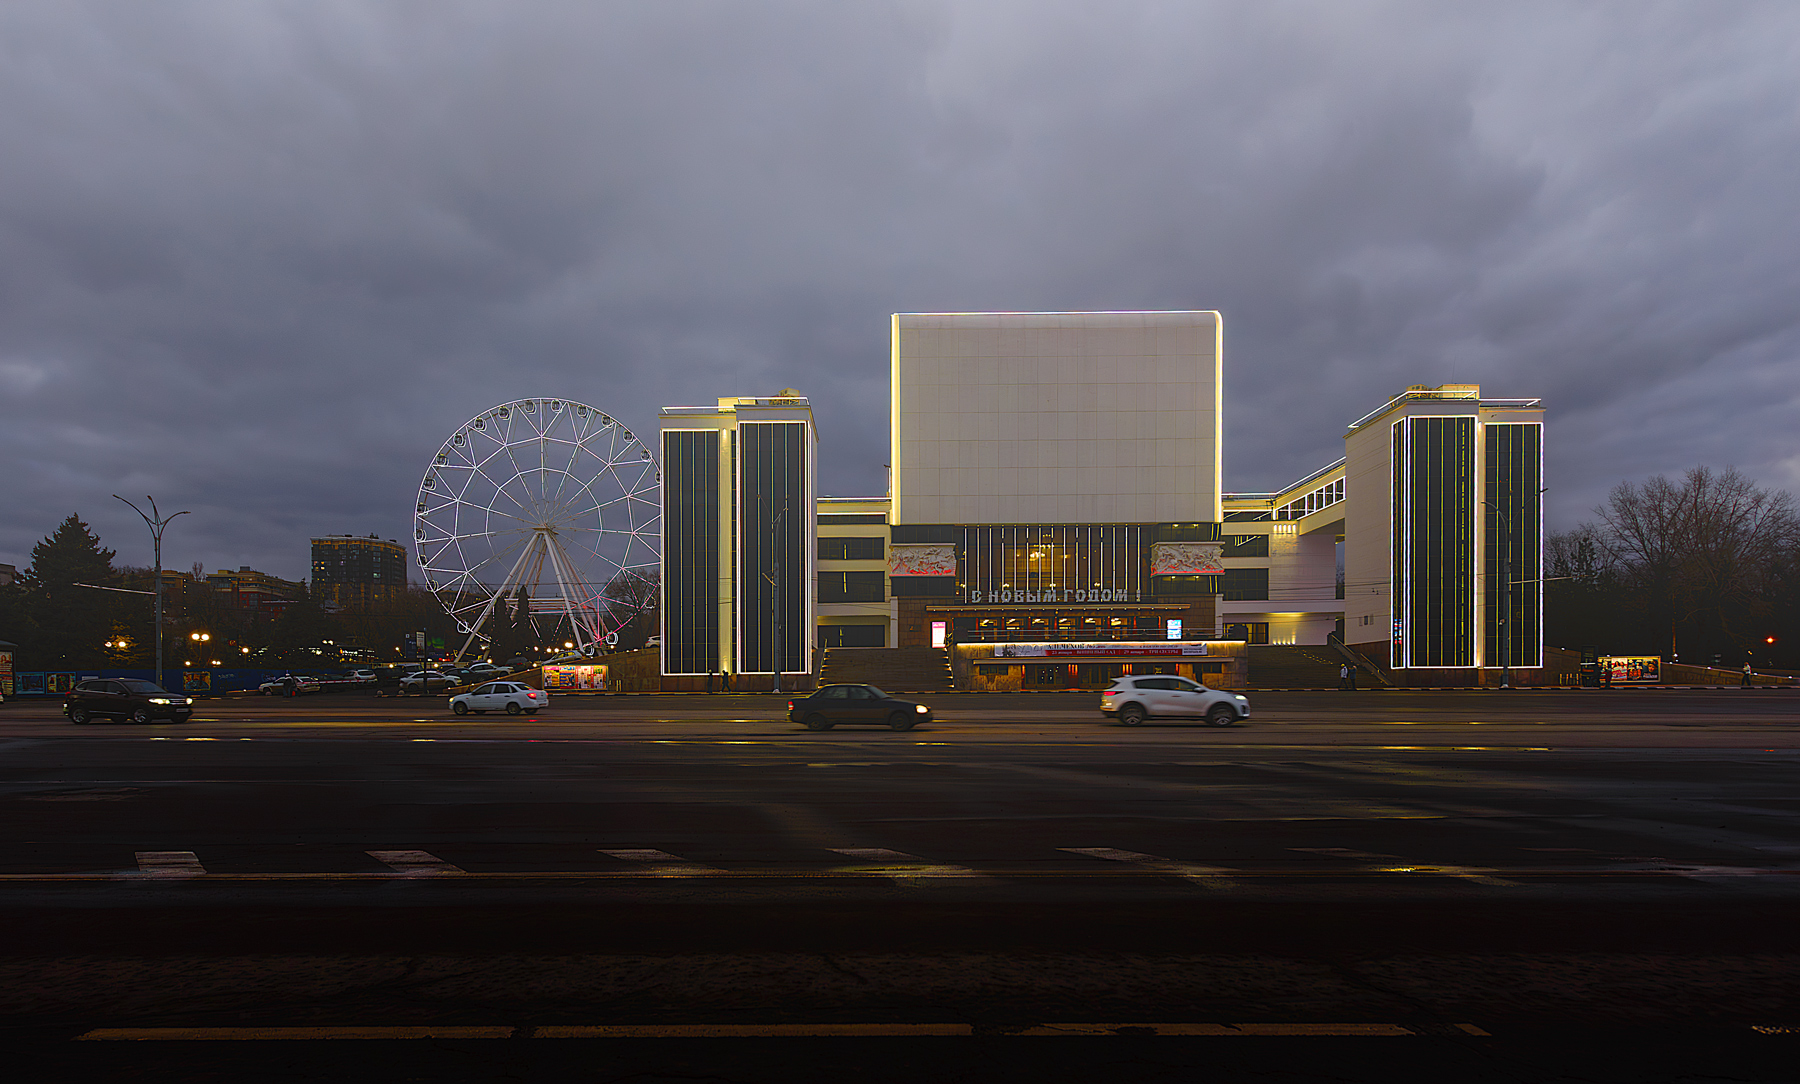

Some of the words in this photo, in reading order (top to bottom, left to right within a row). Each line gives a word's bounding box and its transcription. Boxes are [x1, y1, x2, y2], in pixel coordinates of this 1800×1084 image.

[971, 590, 982, 603] С
[988, 589, 1057, 603] НОВЫМ
[1063, 589, 1128, 602] ГОДОМ
